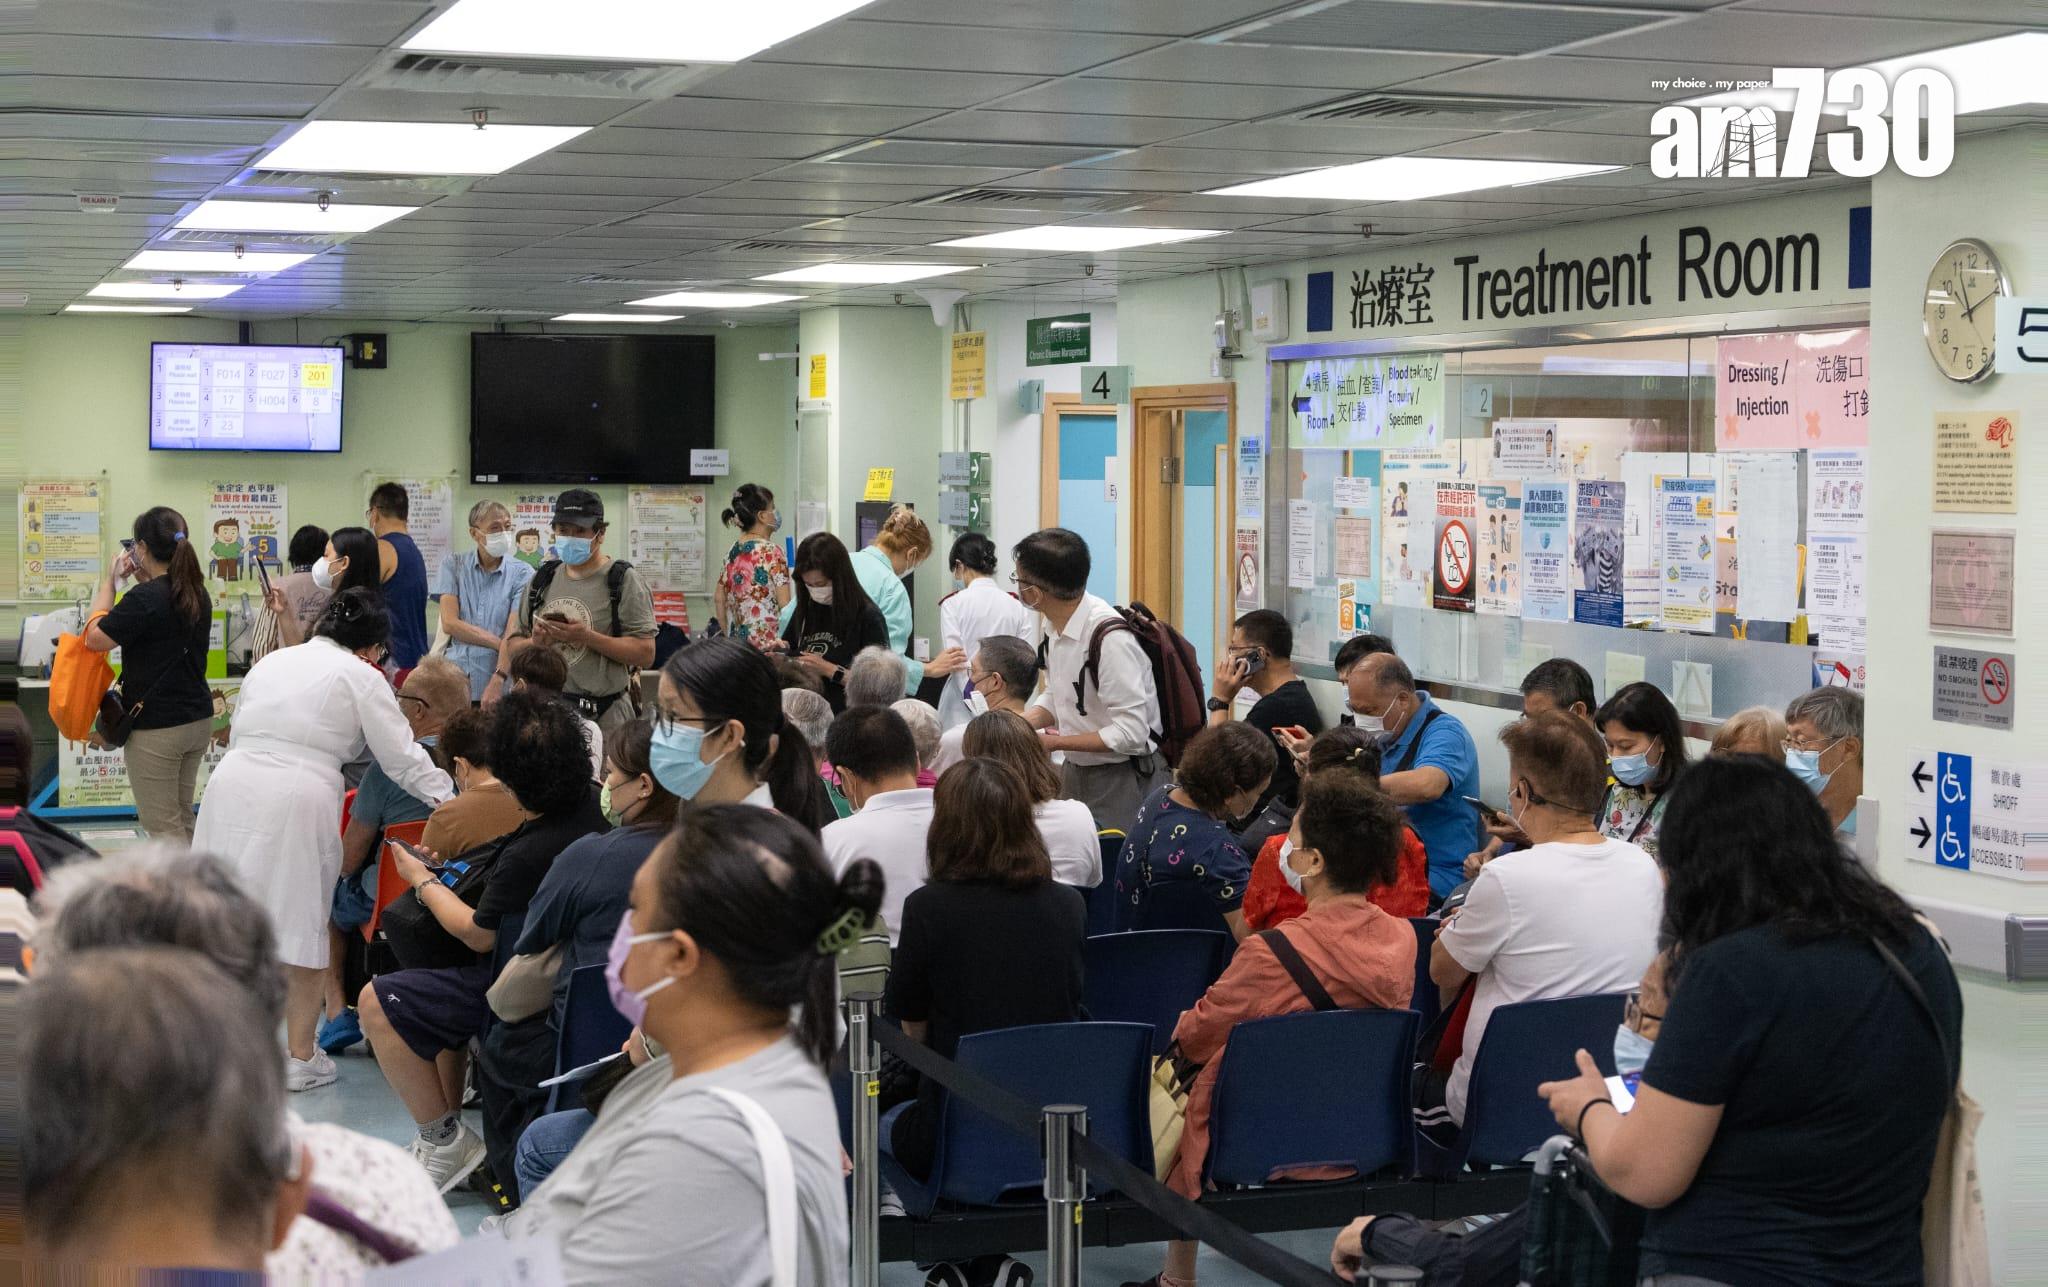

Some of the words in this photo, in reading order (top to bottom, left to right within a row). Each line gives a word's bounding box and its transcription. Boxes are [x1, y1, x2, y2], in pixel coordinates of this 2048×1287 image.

[1968, 253, 1978, 269] 12
[1350, 262, 1434, 329] 治療室
[1454, 234, 1652, 321] Treatment
[1678, 226, 1819, 302] Room
[1943, 280, 1953, 296] 10
[1939, 304, 1945, 319] 9
[1941, 329, 1949, 344] 8
[1952, 347, 1959, 363] 7
[1966, 354, 1973, 370] 6
[1981, 347, 1988, 363] 5
[216, 368, 240, 379] F014
[248, 368, 254, 377] 2
[261, 369, 285, 380] F027
[293, 369, 298, 378] 3
[307, 371, 325, 381] 201
[1389, 365, 1409, 380] Blood
[1410, 364, 1433, 381] taking
[1728, 362, 1779, 386] Dressing
[1816, 354, 1863, 383] 洗傷口
[1092, 371, 1110, 399] 4
[1337, 375, 1356, 396] 抽血
[204, 393, 209, 402] 4
[248, 394, 254, 403] 5
[259, 395, 286, 405] H004
[292, 395, 298, 403] 6
[313, 397, 319, 406] 8
[1388, 388, 1414, 405] Enquiry
[1480, 388, 1488, 412] 2
[1337, 402, 1367, 422] 交化驗
[1736, 395, 1789, 420] Injection
[203, 418, 209, 428] 7
[1307, 414, 1328, 429] Room
[1330, 413, 1335, 428] 4
[1389, 412, 1423, 429] Specimen
[1578, 483, 1608, 498] 求診人士
[258, 538, 268, 553] 5
[1938, 654, 1978, 672] 嚴禁吸煙
[1938, 674, 1947, 682] NO
[1948, 675, 1978, 686] SMOKING
[1993, 794, 2019, 811] SHROFF
[1971, 823, 2025, 848] 暢通易達洗
[1971, 848, 2012, 868] ACCESSIBLE
